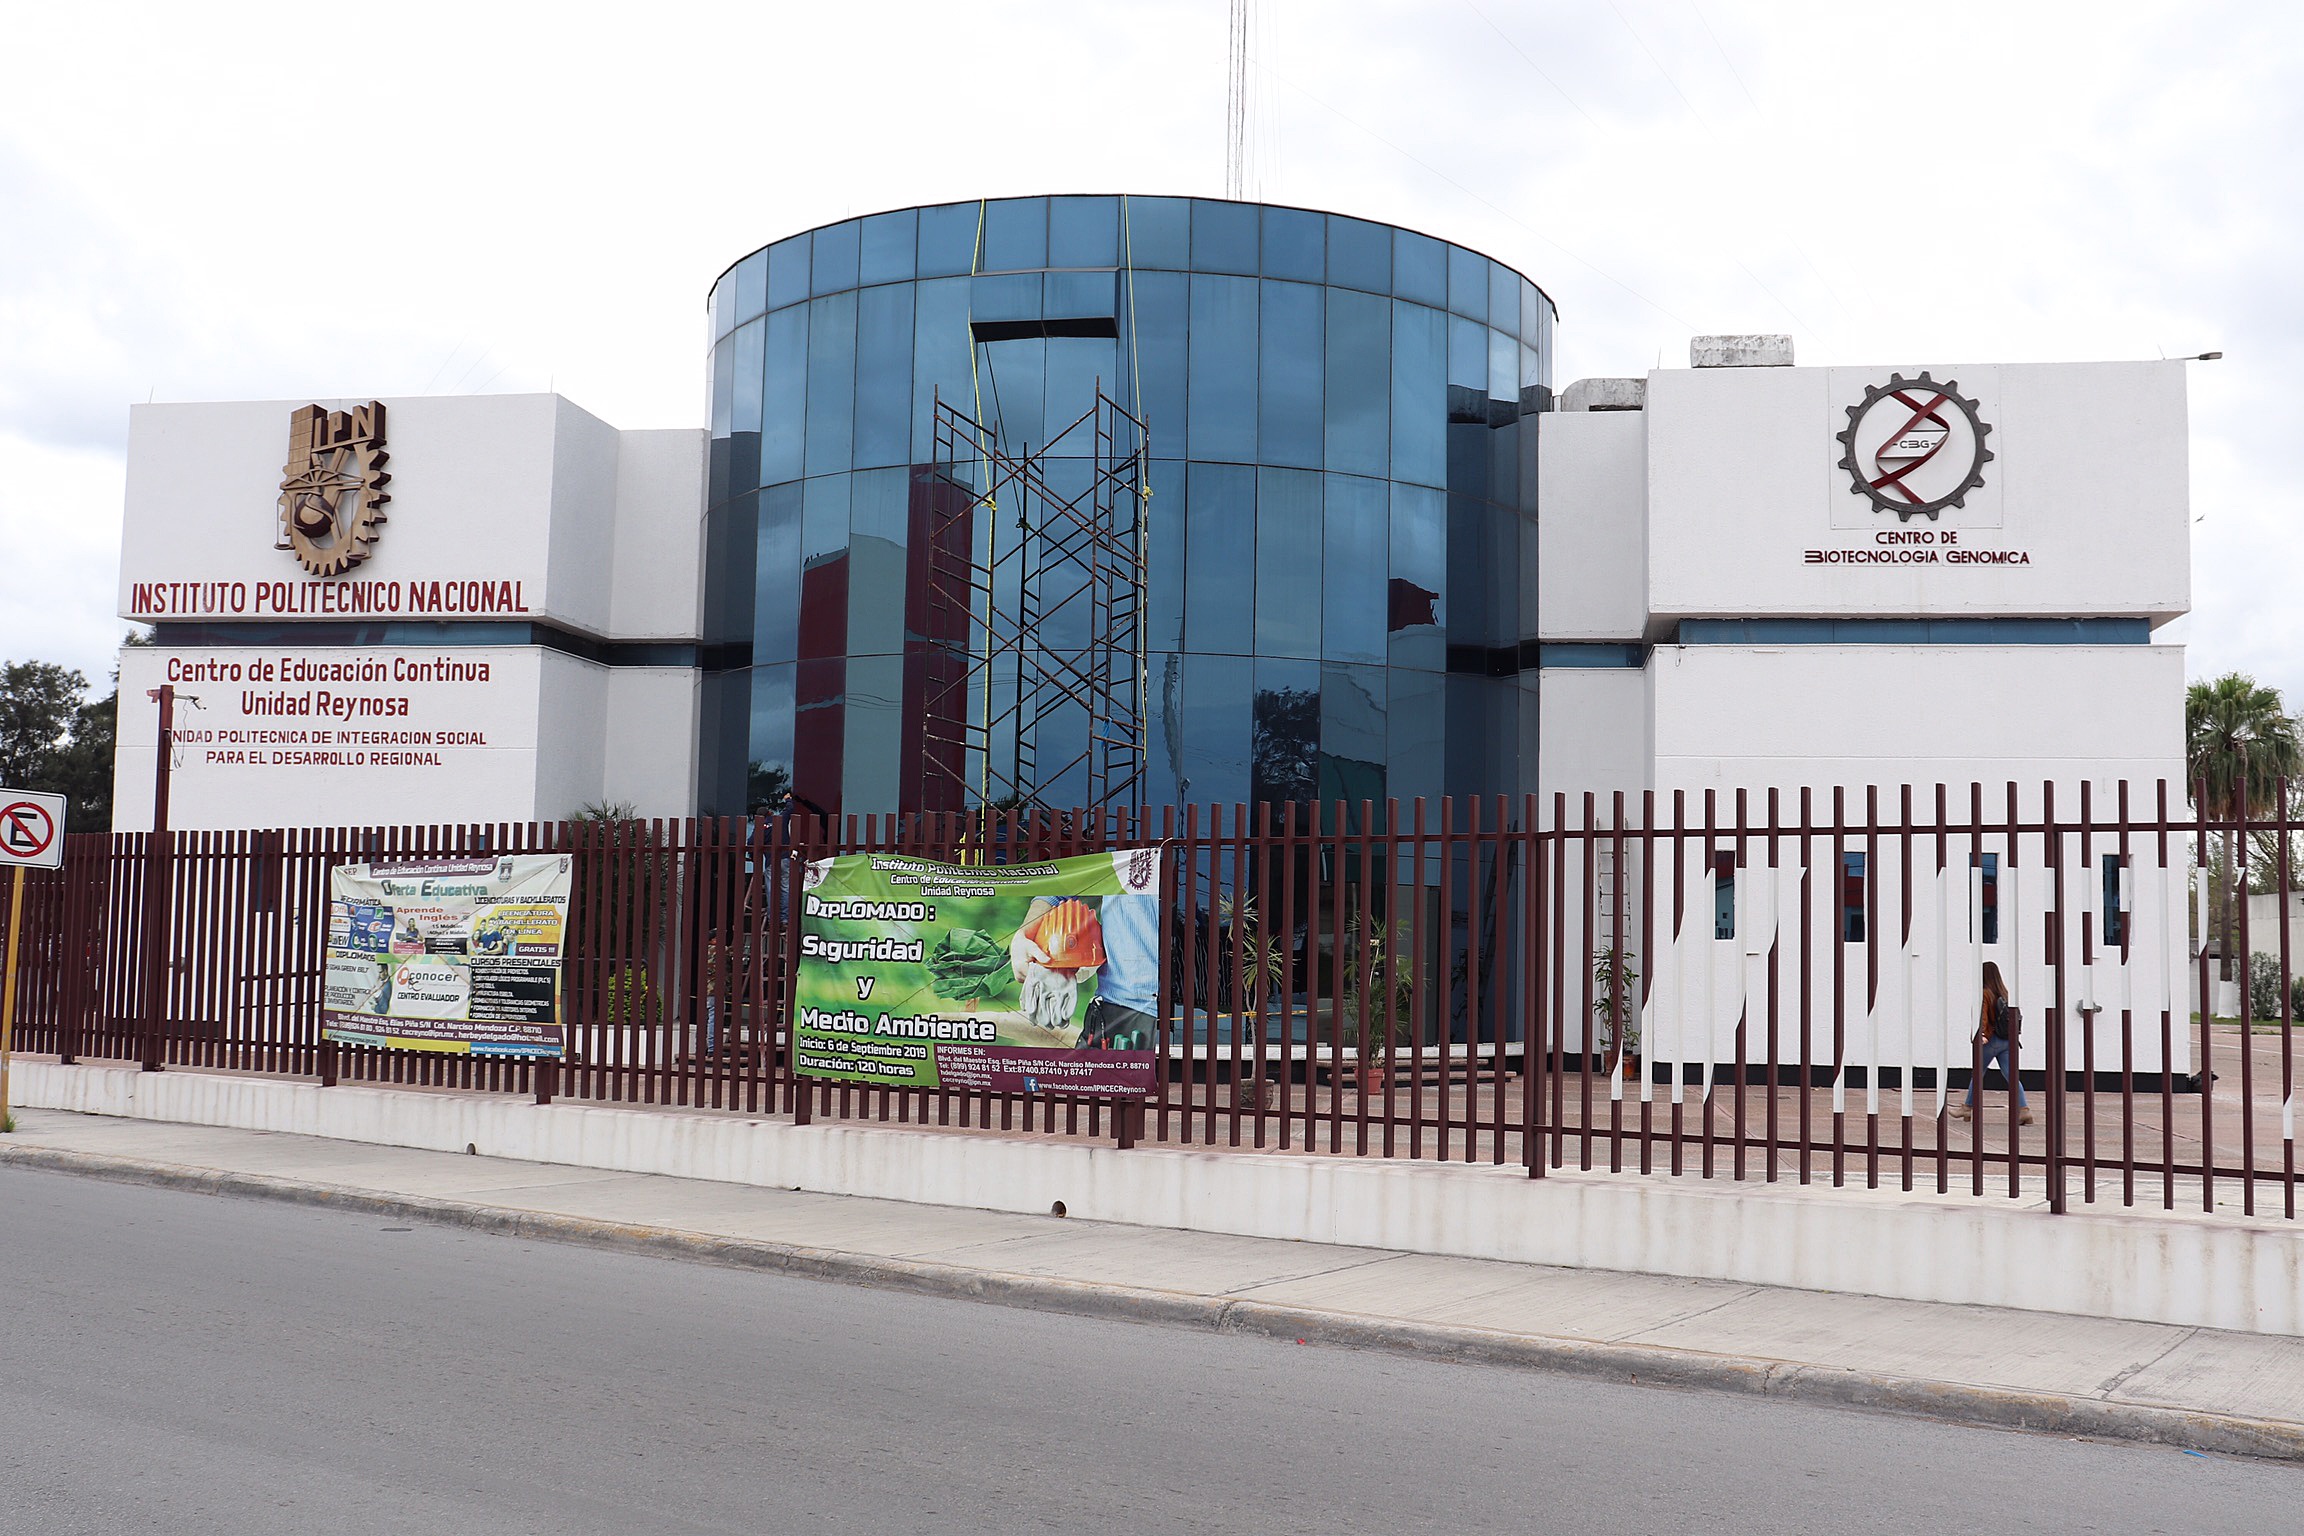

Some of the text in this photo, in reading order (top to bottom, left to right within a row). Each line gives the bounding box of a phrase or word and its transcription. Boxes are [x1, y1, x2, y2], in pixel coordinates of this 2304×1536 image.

[315, 400, 386, 446] IPN
[1900, 440, 1929, 449] CBG
[1875, 531, 1957, 544] CENTRO DE
[1804, 550, 2030, 564] BIOTECNOLOGIA GENOMICA
[131, 581, 528, 613] INSTITUTO POLITECNICO NACIONAL
[168, 657, 489, 682] Centro de Educación Continua
[242, 690, 409, 722] Unidad Reynosa
[172, 730, 487, 745] NIDAD POLITECNICA DE INTEGRACION SOCIAL
[206, 751, 442, 765] PARA EL DESARROLLO REGIONAL
[871, 858, 925, 872] Instituto
[998, 864, 1060, 876] Nacional
[890, 874, 918, 884] Centro
[920, 875, 931, 884] de
[381, 880, 416, 896] Oferta
[921, 886, 995, 898] Unidad Reynosa
[420, 914, 458, 922] Inglés
[802, 935, 923, 962] Seguridad
[502, 959, 561, 967] PRESENCIALES
[408, 972, 459, 982] conocer
[857, 977, 874, 998] y
[397, 992, 460, 1002] CENTRO EVALUADOR
[447, 1022, 473, 1030] Narciso
[474, 1024, 507, 1032] Mendoza
[800, 1007, 996, 1040] Medio Ambiente
[799, 1036, 927, 1058] Inicio: 6 de Septiembre 2019
[937, 1046, 986, 1056] INFORMES EN:
[799, 1055, 915, 1076] Duración: 120 horas
[968, 1063, 981, 1071] 924
[981, 1064, 990, 1072] 81
[1070, 1068, 1093, 1076] 87417
[1084, 1061, 1115, 1069] Mendoza
